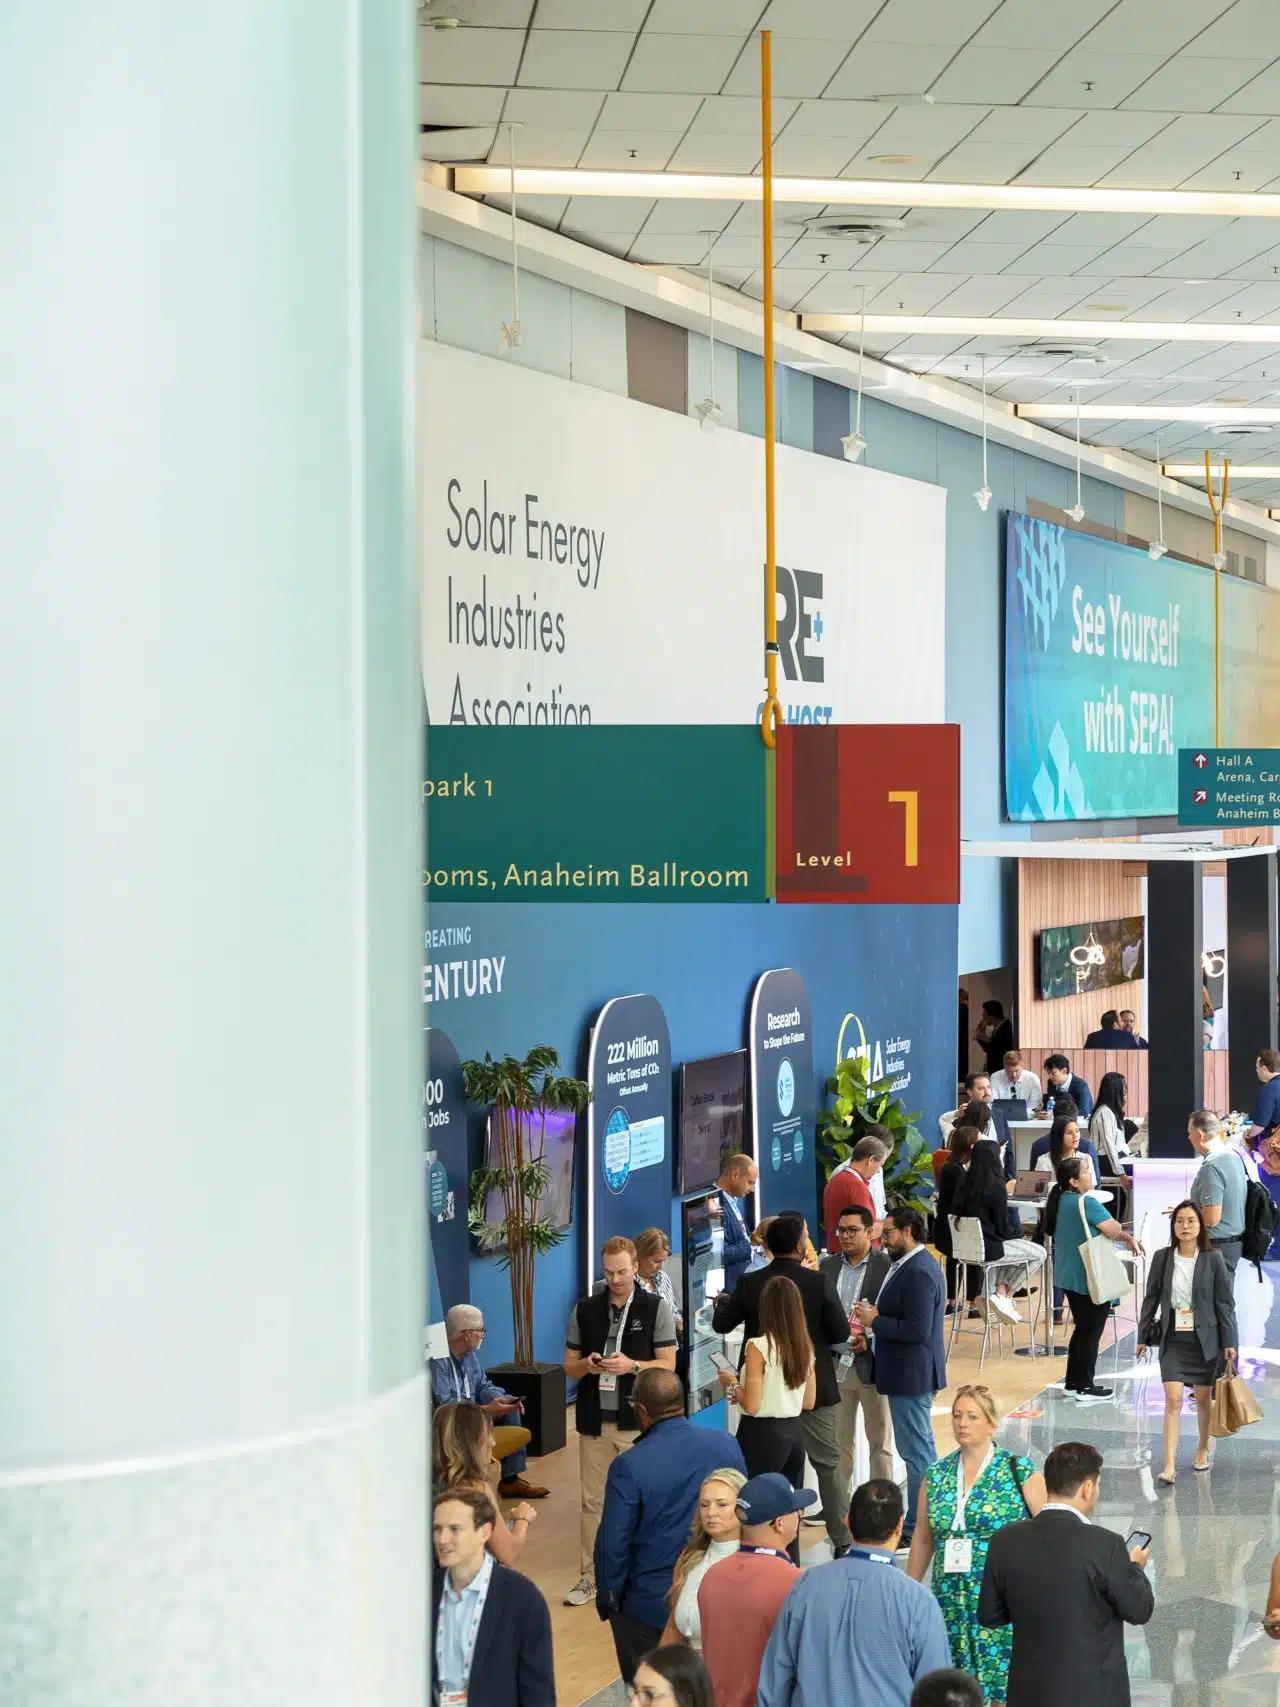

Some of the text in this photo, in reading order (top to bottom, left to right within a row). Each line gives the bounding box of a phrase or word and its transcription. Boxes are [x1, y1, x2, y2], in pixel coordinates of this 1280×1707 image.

[447, 479, 605, 589] Solar Energy
[448, 575, 566, 654] Industries
[1071, 584, 1181, 668] See Yourself
[450, 672, 592, 725] Association
[1084, 684, 1176, 756] with SEPA!
[1216, 755, 1253, 766] Hall A
[484, 780, 493, 797] 1
[1216, 772, 1255, 783] Arena,
[1216, 792, 1265, 805] Meeting
[1216, 808, 1269, 819] Anaheim
[888, 791, 918, 867] 1
[796, 851, 851, 867] Level
[504, 862, 619, 887] Anaheim
[631, 862, 749, 887] Ballroom
[424, 926, 472, 949] REATING
[767, 1007, 800, 1031] Research
[607, 1035, 659, 1064] 222 Million
[769, 1036, 783, 1049] Shape
[790, 1032, 805, 1044] Future
[606, 1069, 626, 1085] Metric
[626, 1067, 641, 1080] Tons
[641, 1063, 648, 1077] of
[428, 1108, 450, 1128] Jobs
